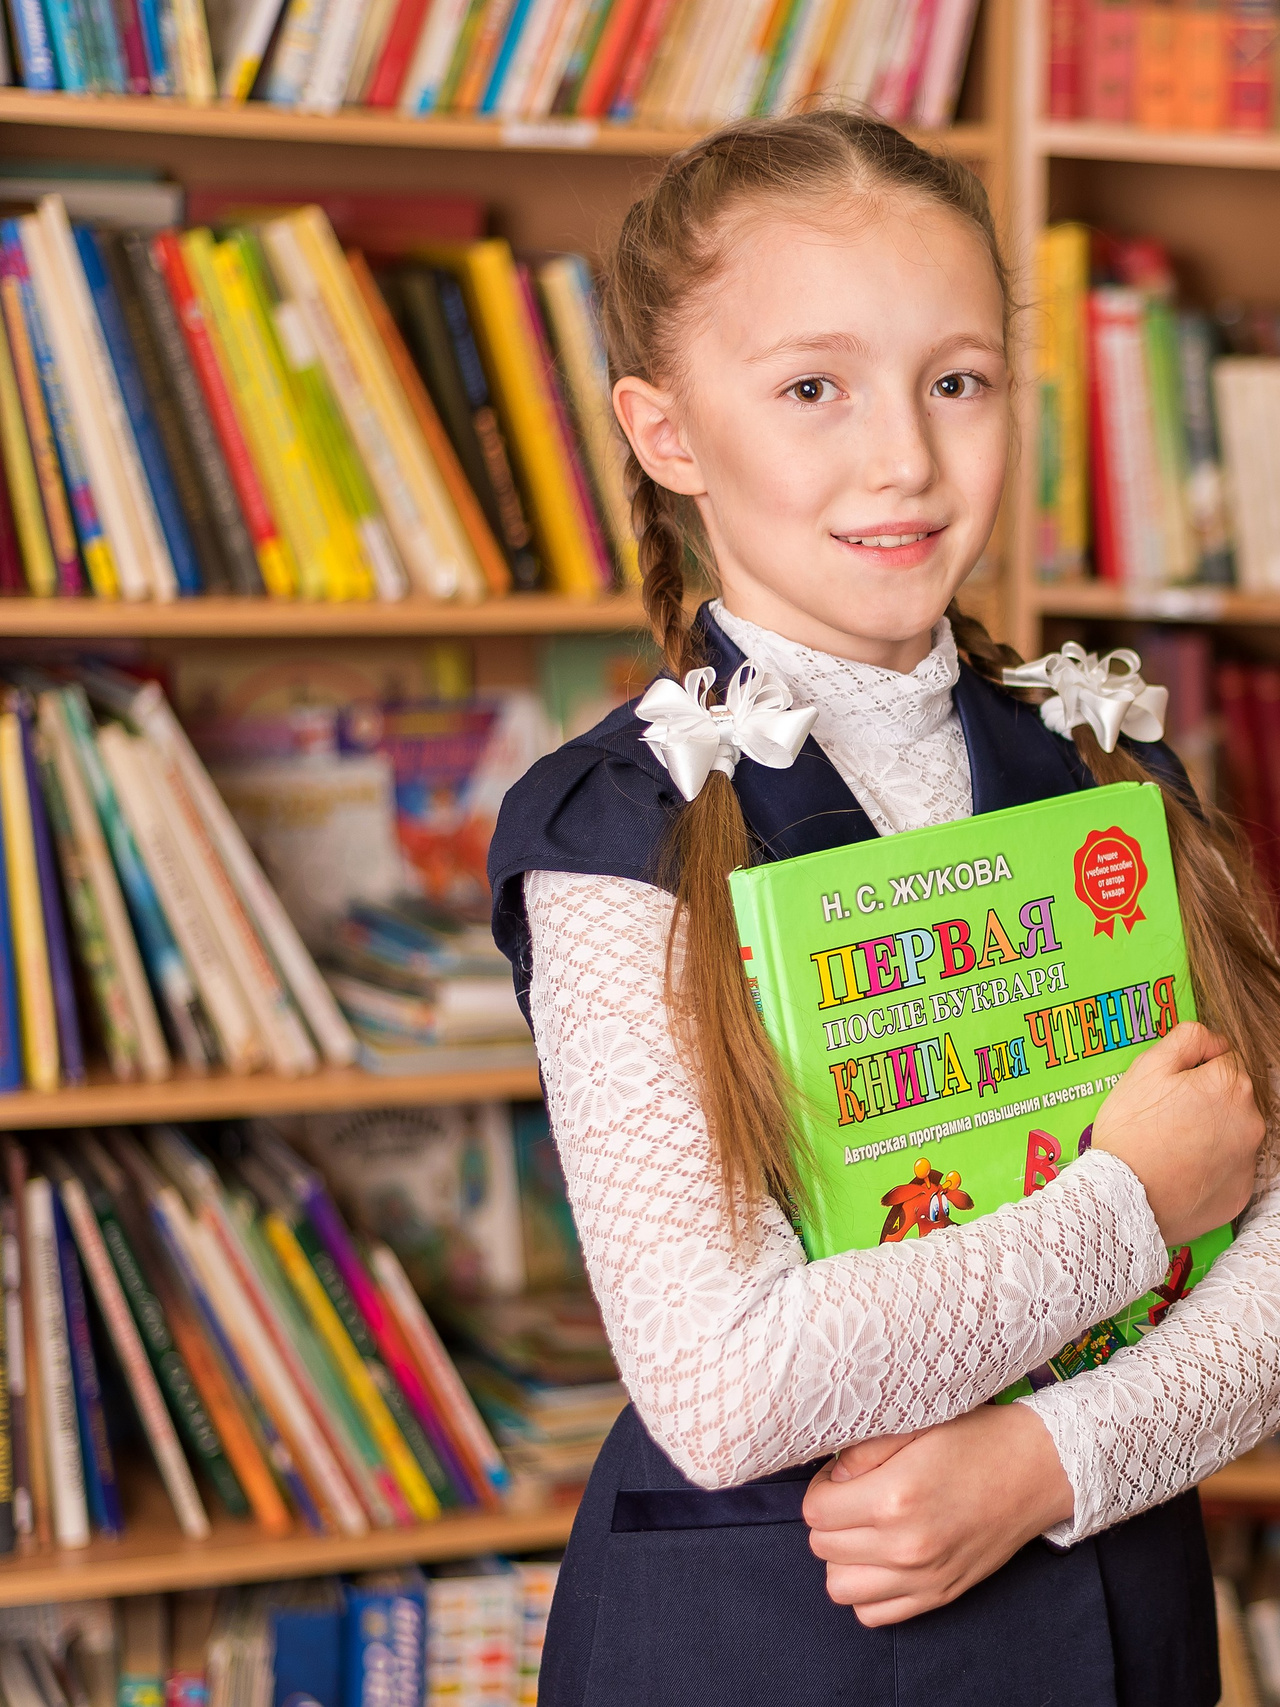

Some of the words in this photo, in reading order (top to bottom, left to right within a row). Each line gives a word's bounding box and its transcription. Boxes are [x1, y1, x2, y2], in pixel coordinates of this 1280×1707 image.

[1086, 866, 1109, 880] учебное
[1110, 860, 1133, 873] пособие
[1097, 851, 1118, 864] Лучшее
[1098, 879, 1105, 888] от
[1105, 875, 1125, 885] автора
[822, 892, 850, 922] Н.
[856, 885, 884, 913] С.
[889, 855, 1013, 906] ЖУКОВА
[1101, 887, 1125, 900] Букваря
[810, 895, 1062, 1010] ПЕРВАЯ
[823, 998, 927, 1051] ПОСЛЕ
[930, 962, 1069, 1023] БУКВАРЯ
[828, 1033, 972, 1127] КНИГА
[1024, 974, 1179, 1070] ЧТЕНИЯ
[844, 1134, 907, 1165] Авторская
[909, 1116, 972, 1143] программа
[973, 1096, 1041, 1128] повышения
[1042, 1081, 1094, 1108] качества
[1095, 1079, 1104, 1093] и
[1059, 1343, 1087, 1377] КВАРЬ
